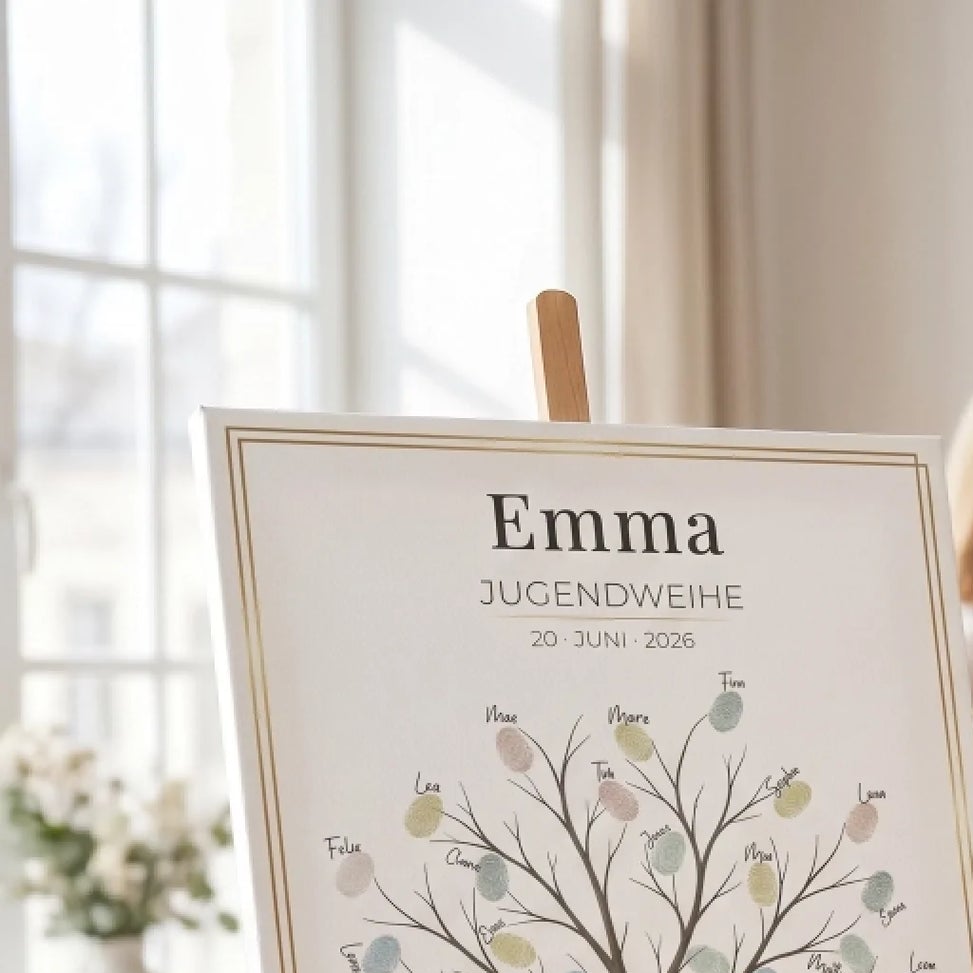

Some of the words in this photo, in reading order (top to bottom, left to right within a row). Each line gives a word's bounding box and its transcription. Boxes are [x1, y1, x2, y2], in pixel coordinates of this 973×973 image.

[486, 493, 725, 556] Emma
[480, 579, 744, 610] JUGENDWEIHE
[530, 630, 558, 648] 20
[573, 630, 626, 649] JUNI
[643, 632, 696, 649] 2026
